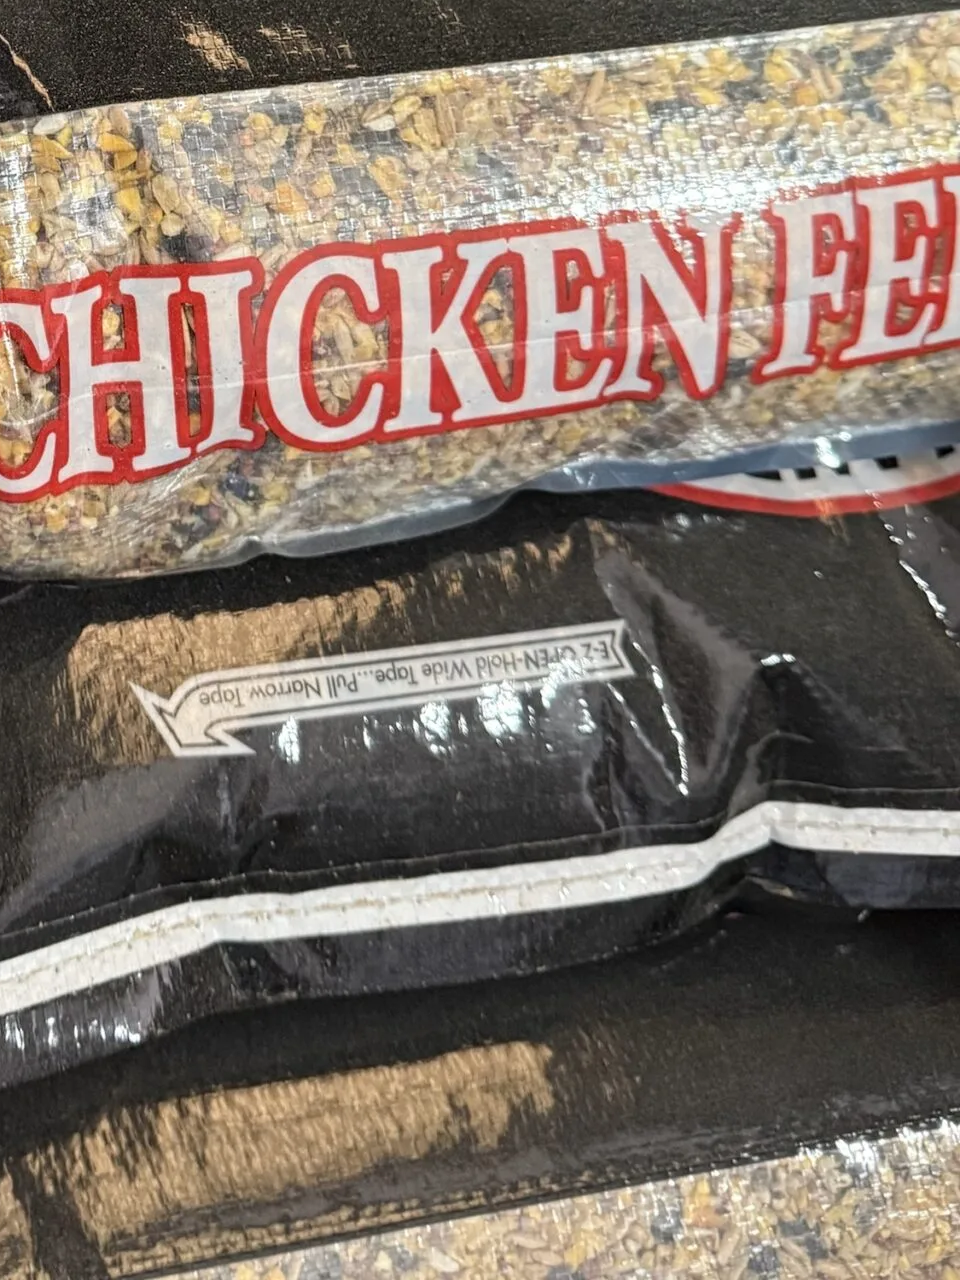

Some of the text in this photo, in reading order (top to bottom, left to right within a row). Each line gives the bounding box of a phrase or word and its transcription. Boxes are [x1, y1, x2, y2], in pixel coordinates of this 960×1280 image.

[751, 163, 960, 384] FE
[580, 639, 610, 660] E-Z
[421, 658, 472, 685] Wide
[199, 683, 245, 708] Tape
[250, 676, 322, 699] Narrow
